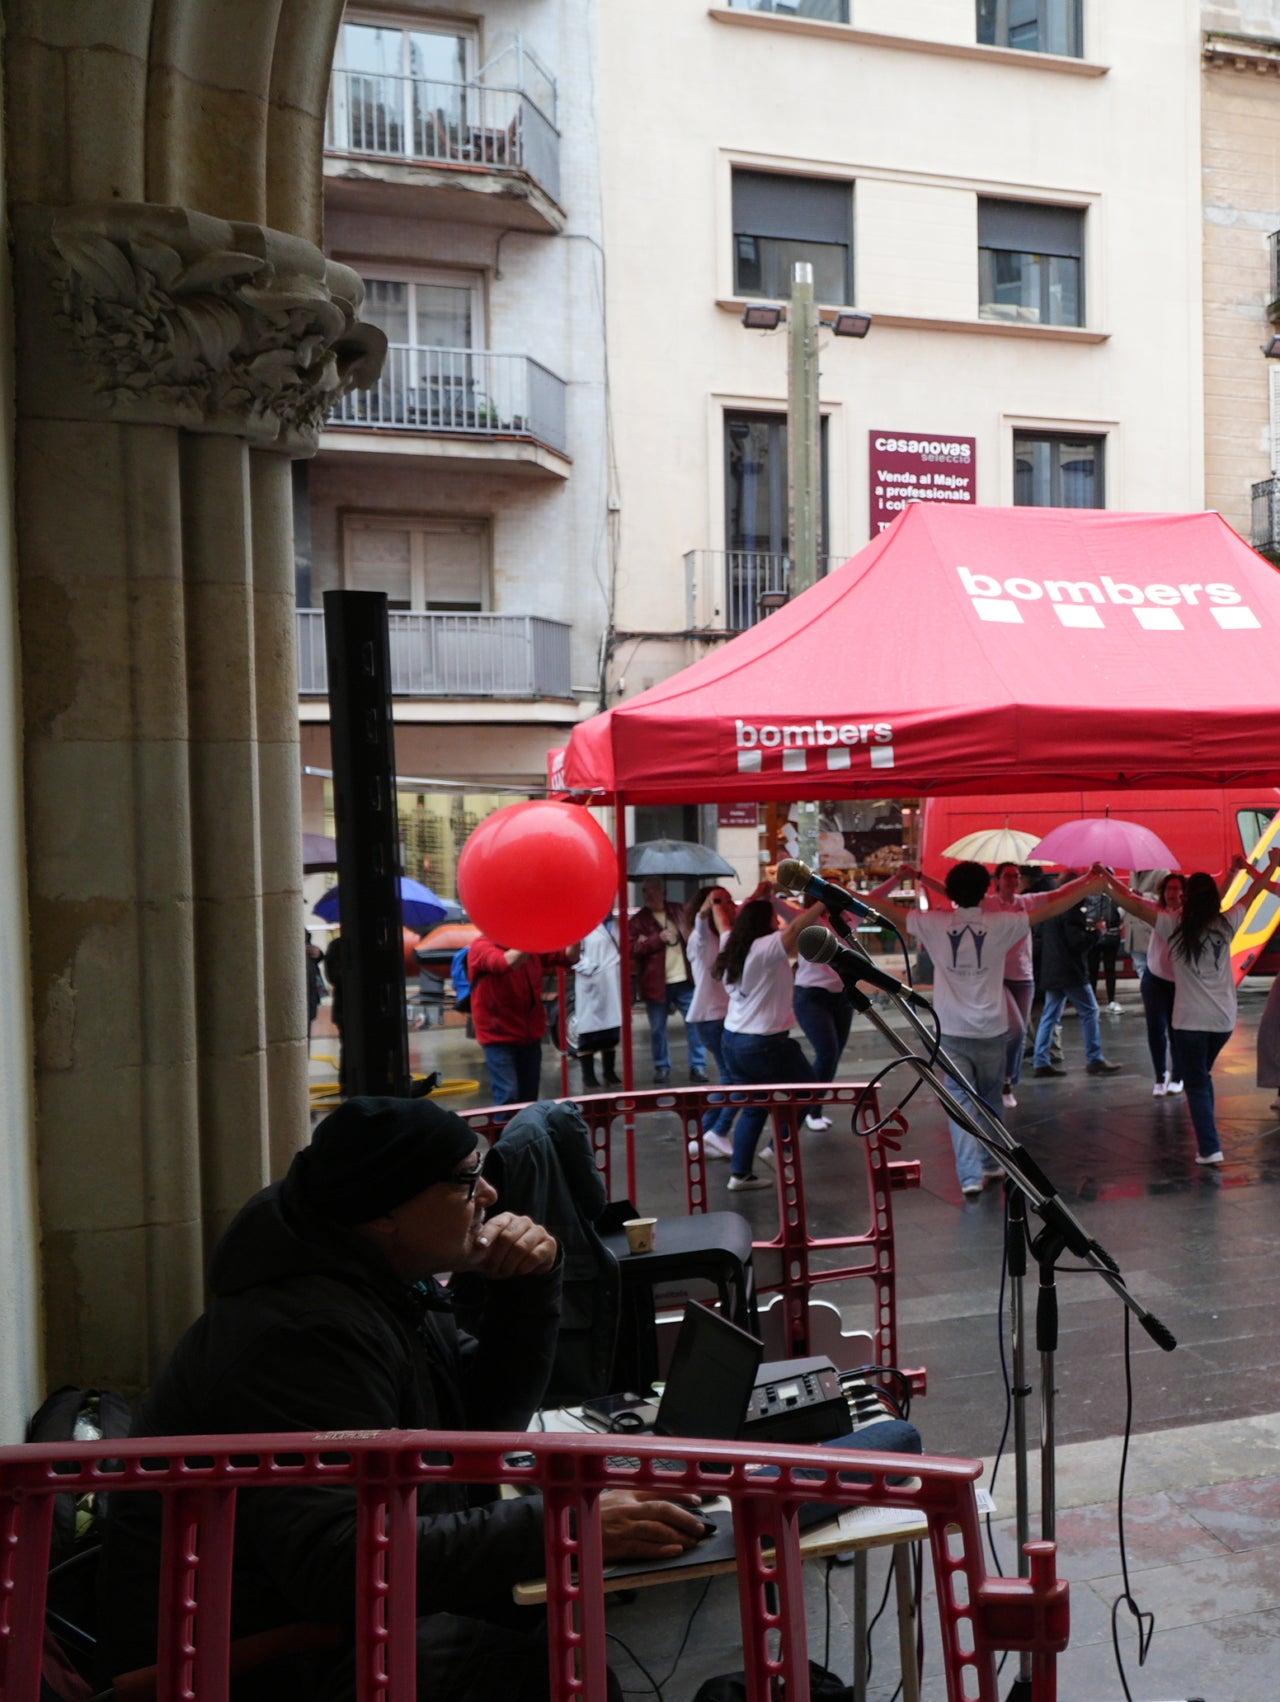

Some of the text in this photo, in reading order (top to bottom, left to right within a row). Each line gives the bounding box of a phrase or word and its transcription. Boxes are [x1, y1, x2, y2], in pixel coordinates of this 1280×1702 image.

[875, 438, 971, 457] casanovas
[877, 470, 969, 489] Venda al Major
[875, 486, 971, 500] a professionals
[957, 566, 1242, 605] bombers
[735, 720, 893, 748] bombers
